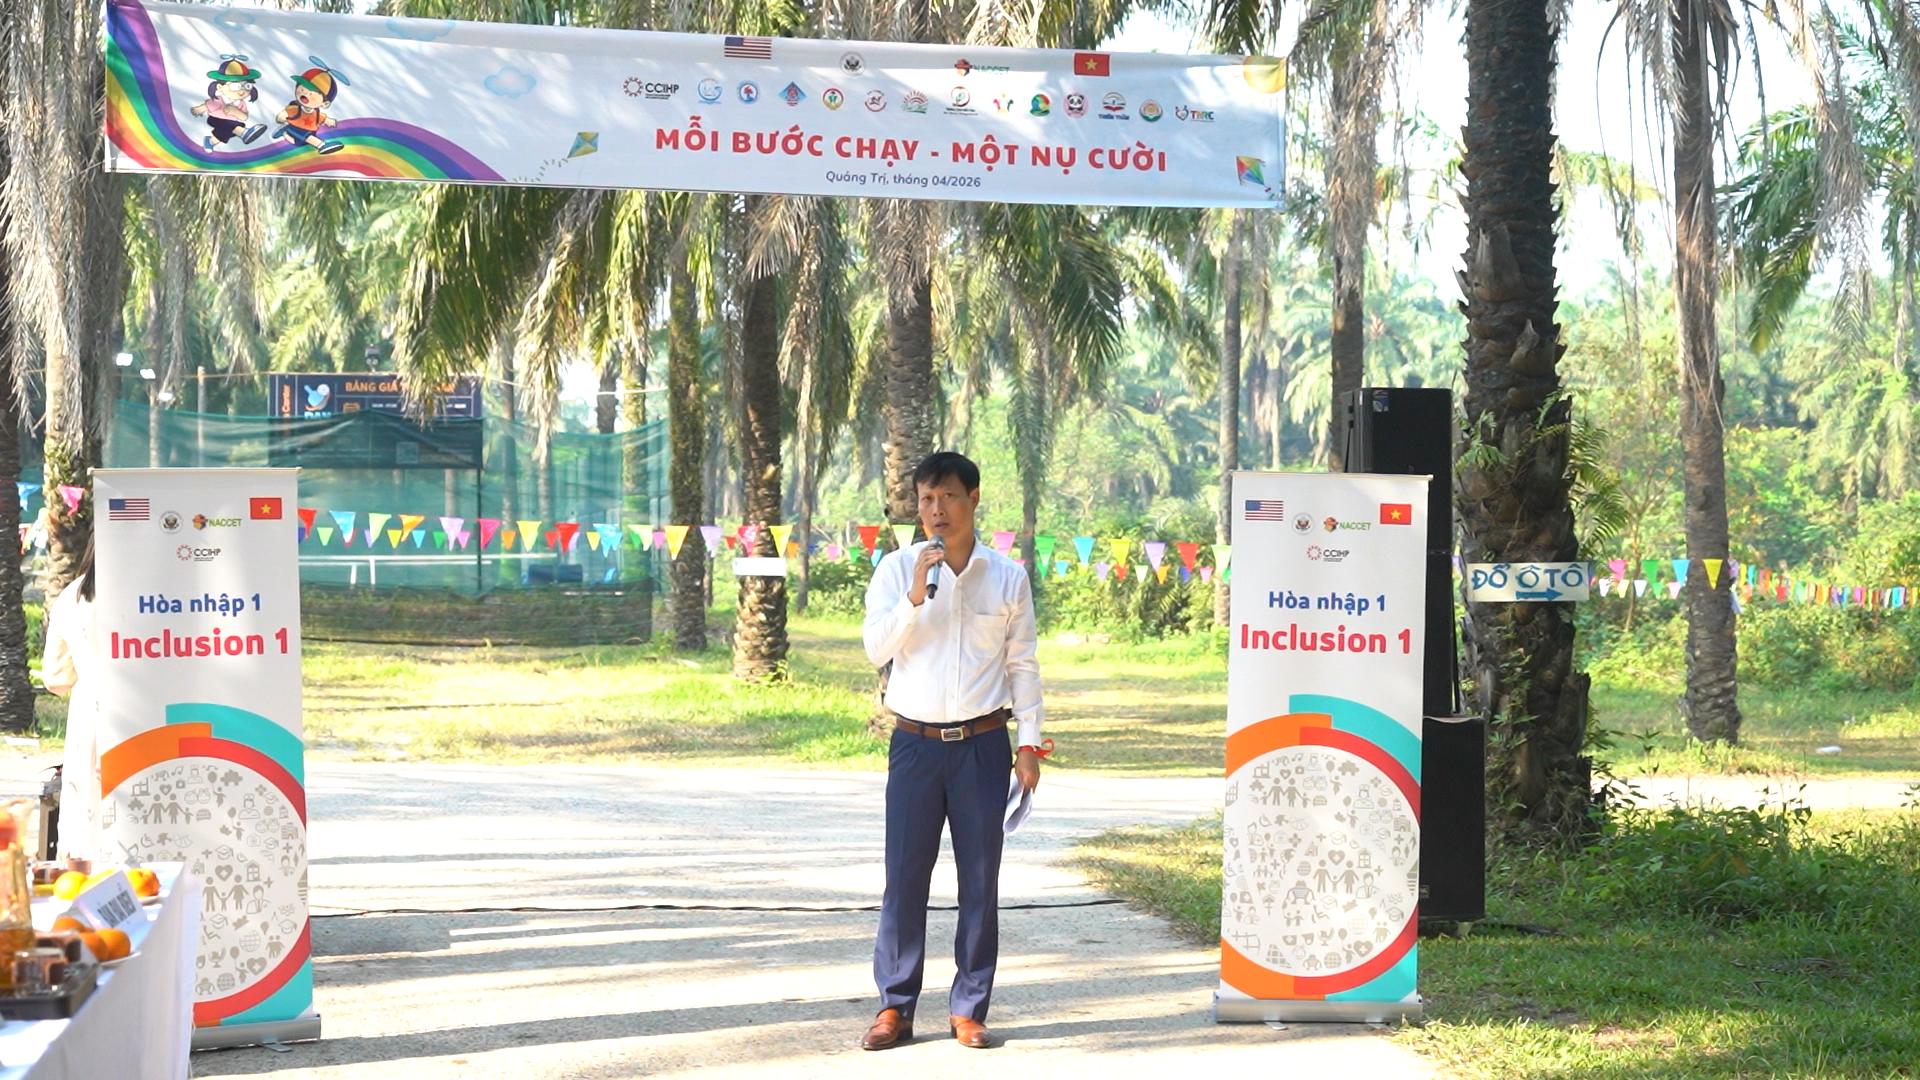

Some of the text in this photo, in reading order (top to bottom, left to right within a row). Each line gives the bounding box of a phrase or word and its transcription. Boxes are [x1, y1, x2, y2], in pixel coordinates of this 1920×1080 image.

[645, 82, 680, 95] CCIHP
[656, 115, 719, 152] MỖI
[732, 124, 824, 157] BƯỚC
[835, 136, 919, 167] CHẠY
[952, 134, 1019, 172] MỘT
[1031, 146, 1076, 175] NỤ
[1088, 141, 1166, 171] CƯỜI
[893, 173, 928, 187] tháng
[931, 175, 982, 188] 04/2026
[208, 518, 242, 527] NACCET
[1339, 522, 1372, 531] NACCET
[193, 548, 221, 557] CCIHP
[1322, 549, 1350, 558] CCIHP
[138, 593, 260, 617] Hòa nhập 1
[1269, 590, 1385, 616] Hòa nhập 1
[111, 627, 288, 659] Inclusion 1
[1241, 623, 1410, 654] Inclusion 1
